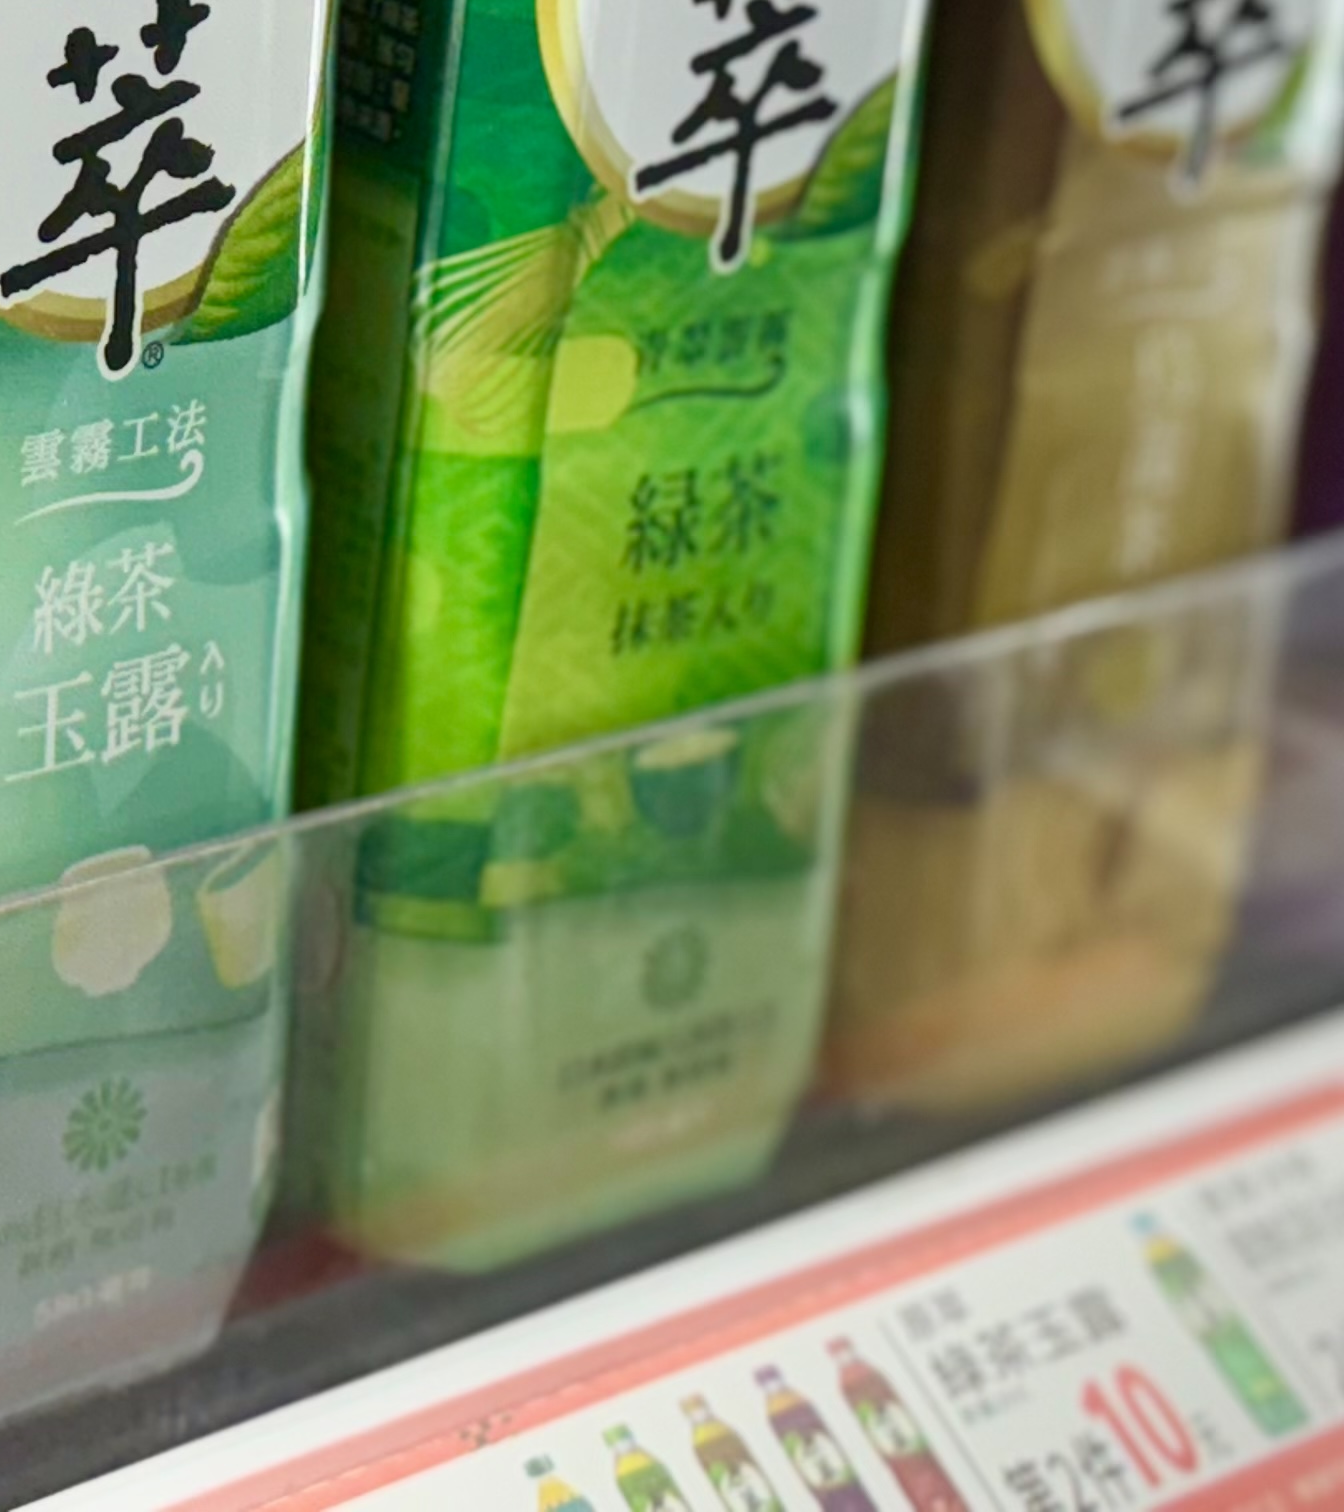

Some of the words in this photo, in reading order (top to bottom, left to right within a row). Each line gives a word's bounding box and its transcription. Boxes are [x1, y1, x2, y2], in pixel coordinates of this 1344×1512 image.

[19, 398, 207, 486] 雲霧工法
[5, 643, 191, 783] 玉露
[199, 640, 225, 719] 入り
